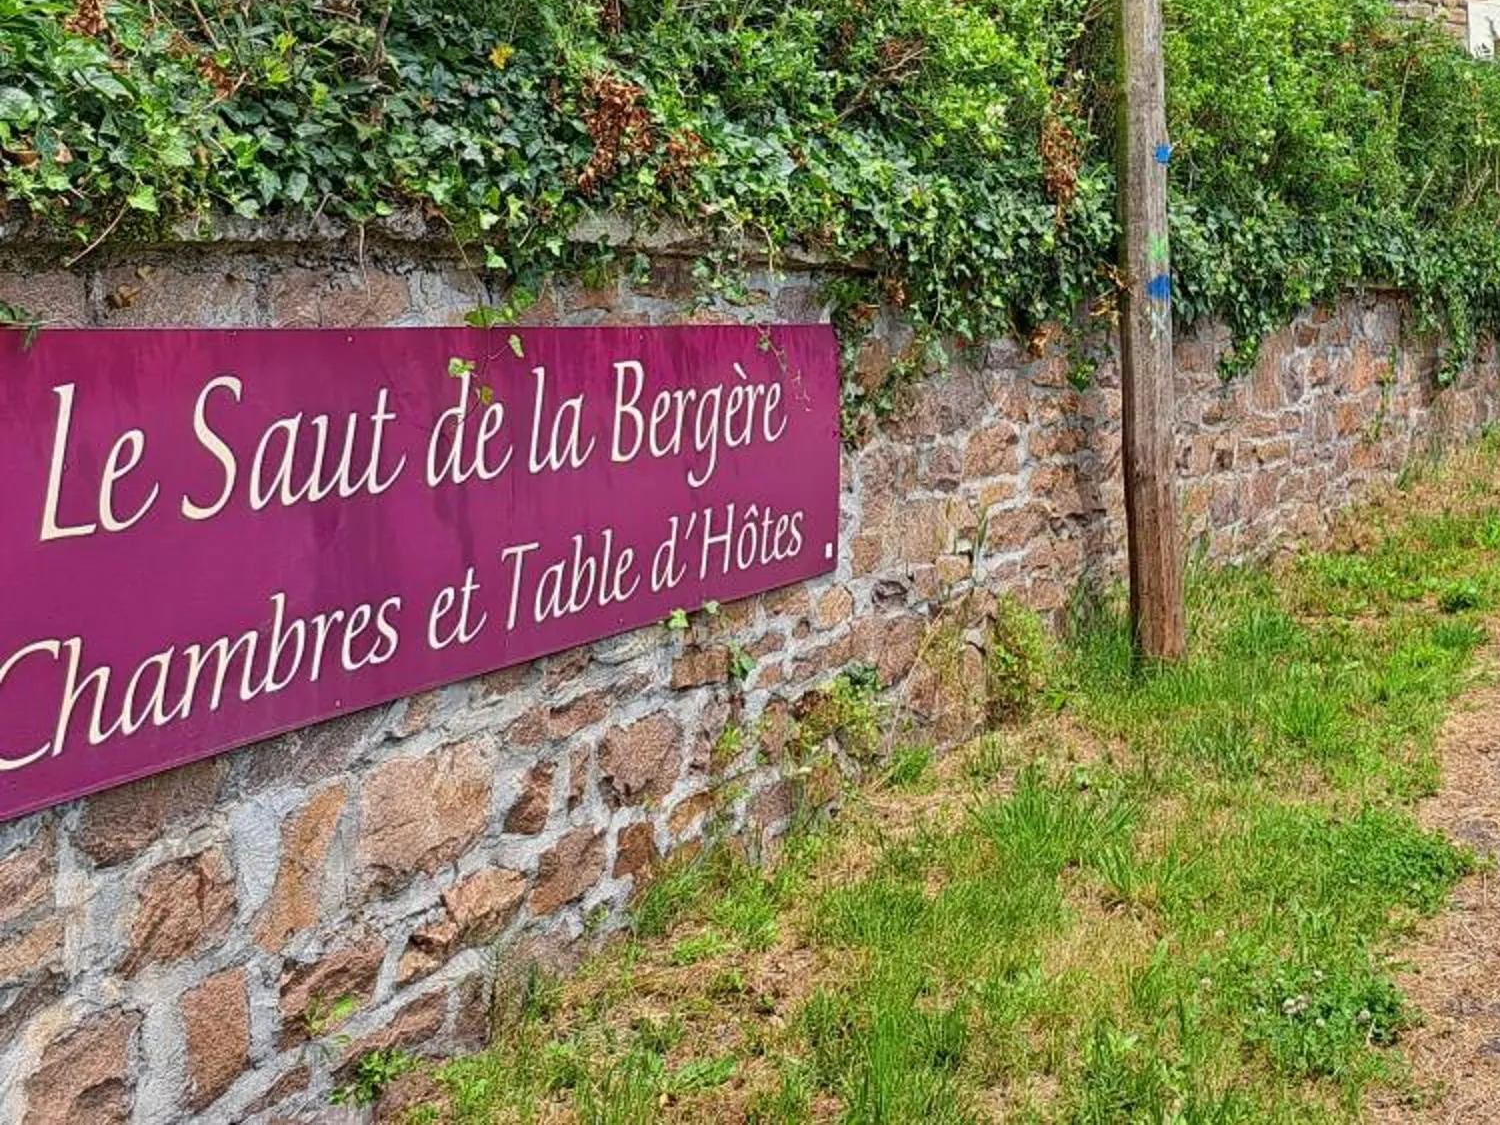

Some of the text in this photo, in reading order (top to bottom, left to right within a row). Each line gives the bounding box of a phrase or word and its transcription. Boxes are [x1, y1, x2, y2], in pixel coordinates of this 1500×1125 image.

[39, 360, 787, 541] Le Saut de la Bergère
[0, 503, 803, 771] Chambres et Table d'Hôtes
